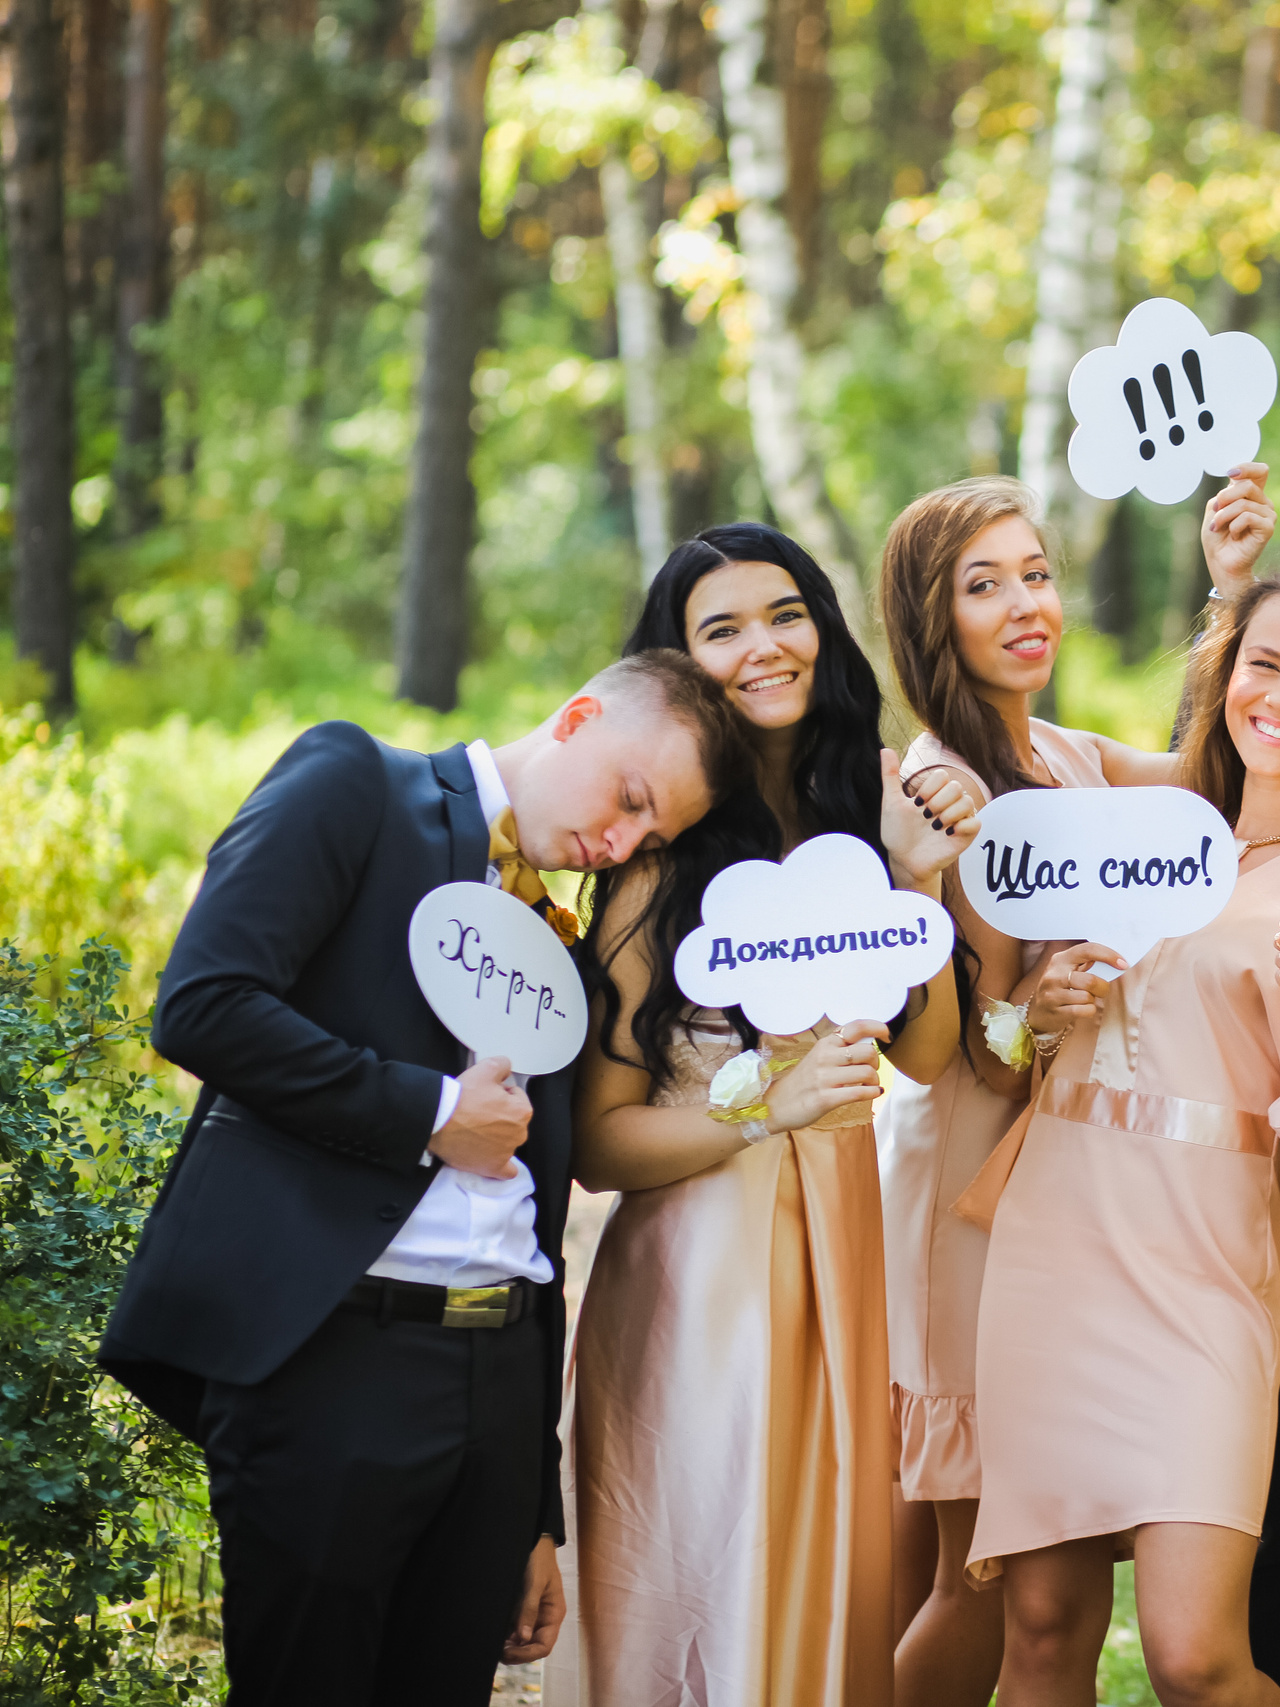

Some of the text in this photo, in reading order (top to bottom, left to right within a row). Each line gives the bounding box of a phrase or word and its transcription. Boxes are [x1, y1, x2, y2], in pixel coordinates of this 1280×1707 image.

[1122, 348, 1215, 461] !!!
[980, 835, 1213, 903] Щас спою!
[708, 917, 928, 973] Дождались!
